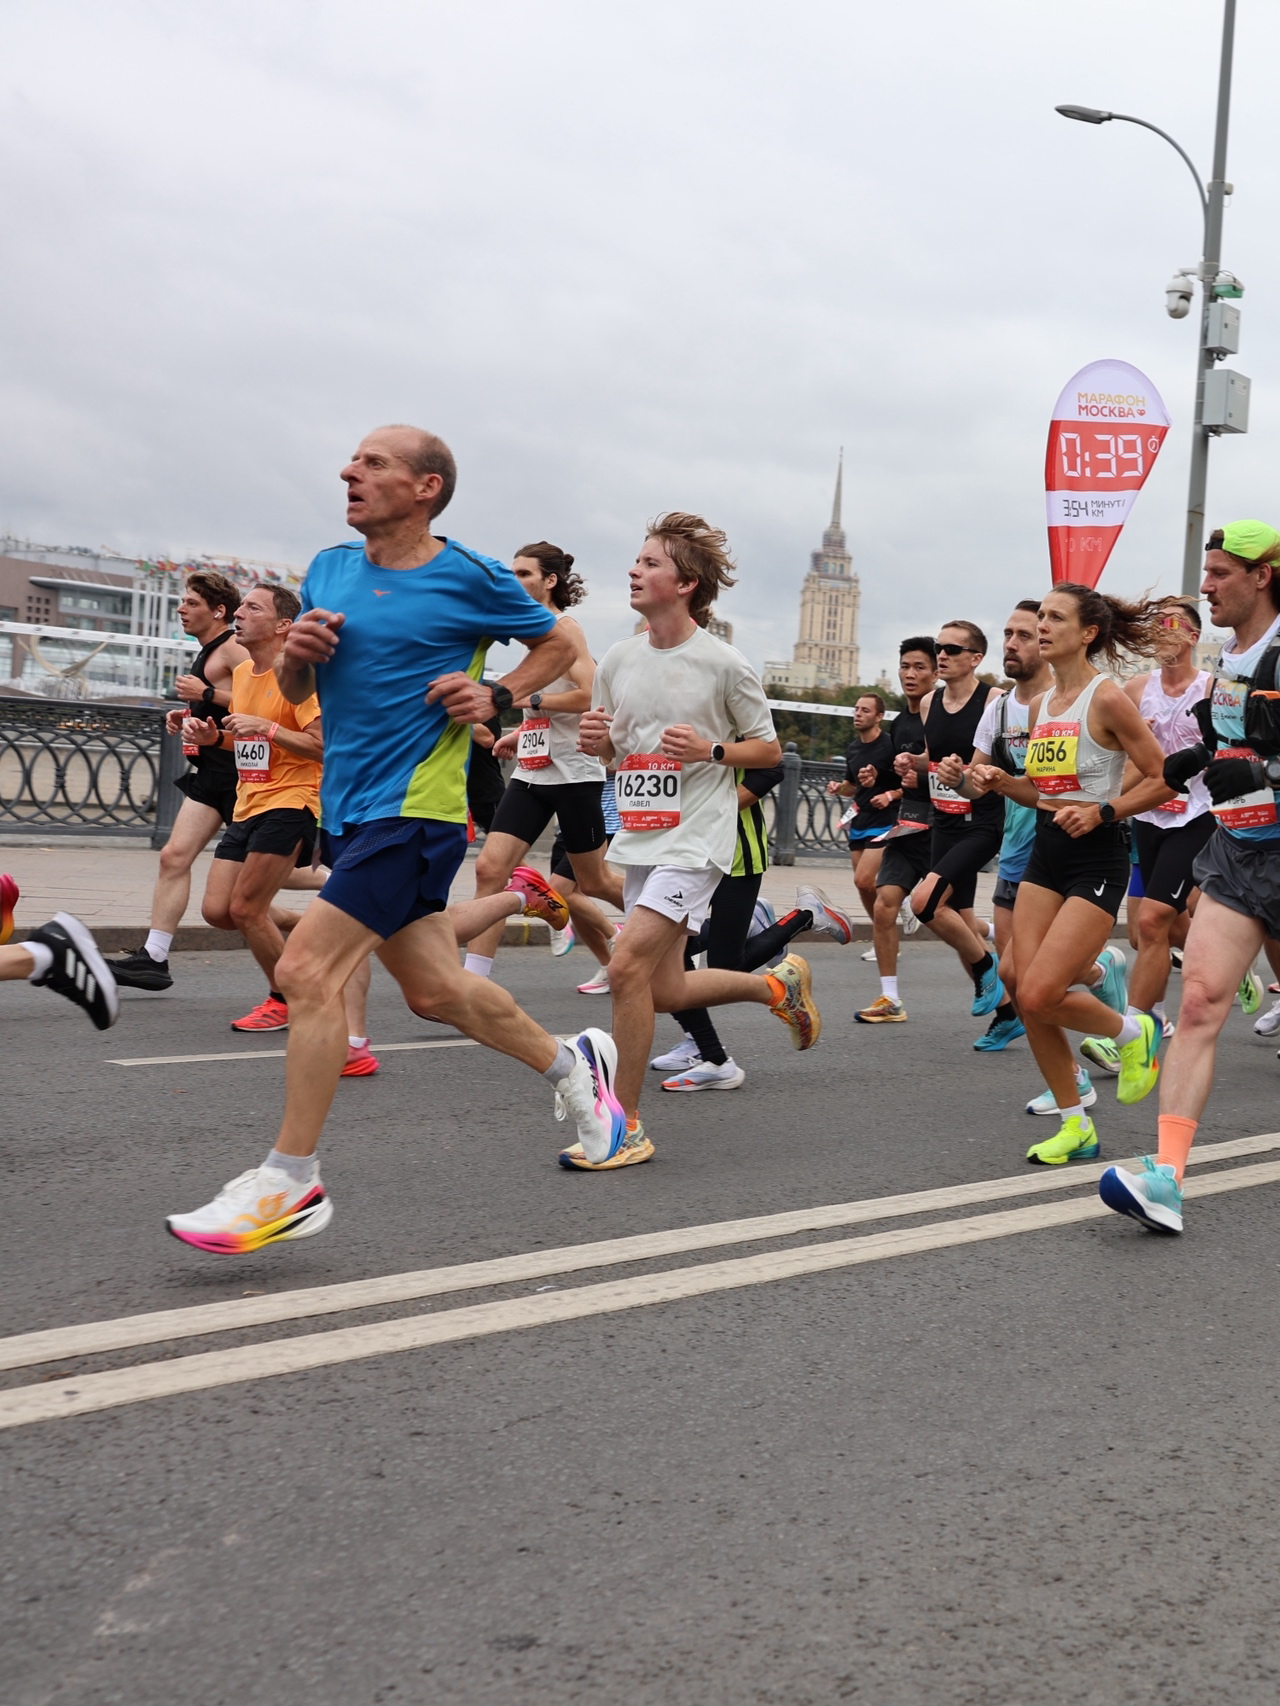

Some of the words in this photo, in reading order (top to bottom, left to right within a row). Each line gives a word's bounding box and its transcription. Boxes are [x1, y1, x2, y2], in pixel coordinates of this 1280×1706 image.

[1077, 392, 1146, 407] МАРАФОН
[1078, 404, 1136, 418] МОСКВА
[1060, 432, 1143, 478] 0:39
[1091, 509, 1104, 517] КМ
[522, 731, 545, 748] 2904
[1029, 740, 1067, 764] 7056
[617, 774, 678, 798] 16230
[628, 800, 651, 808] ПАВЕЛ
